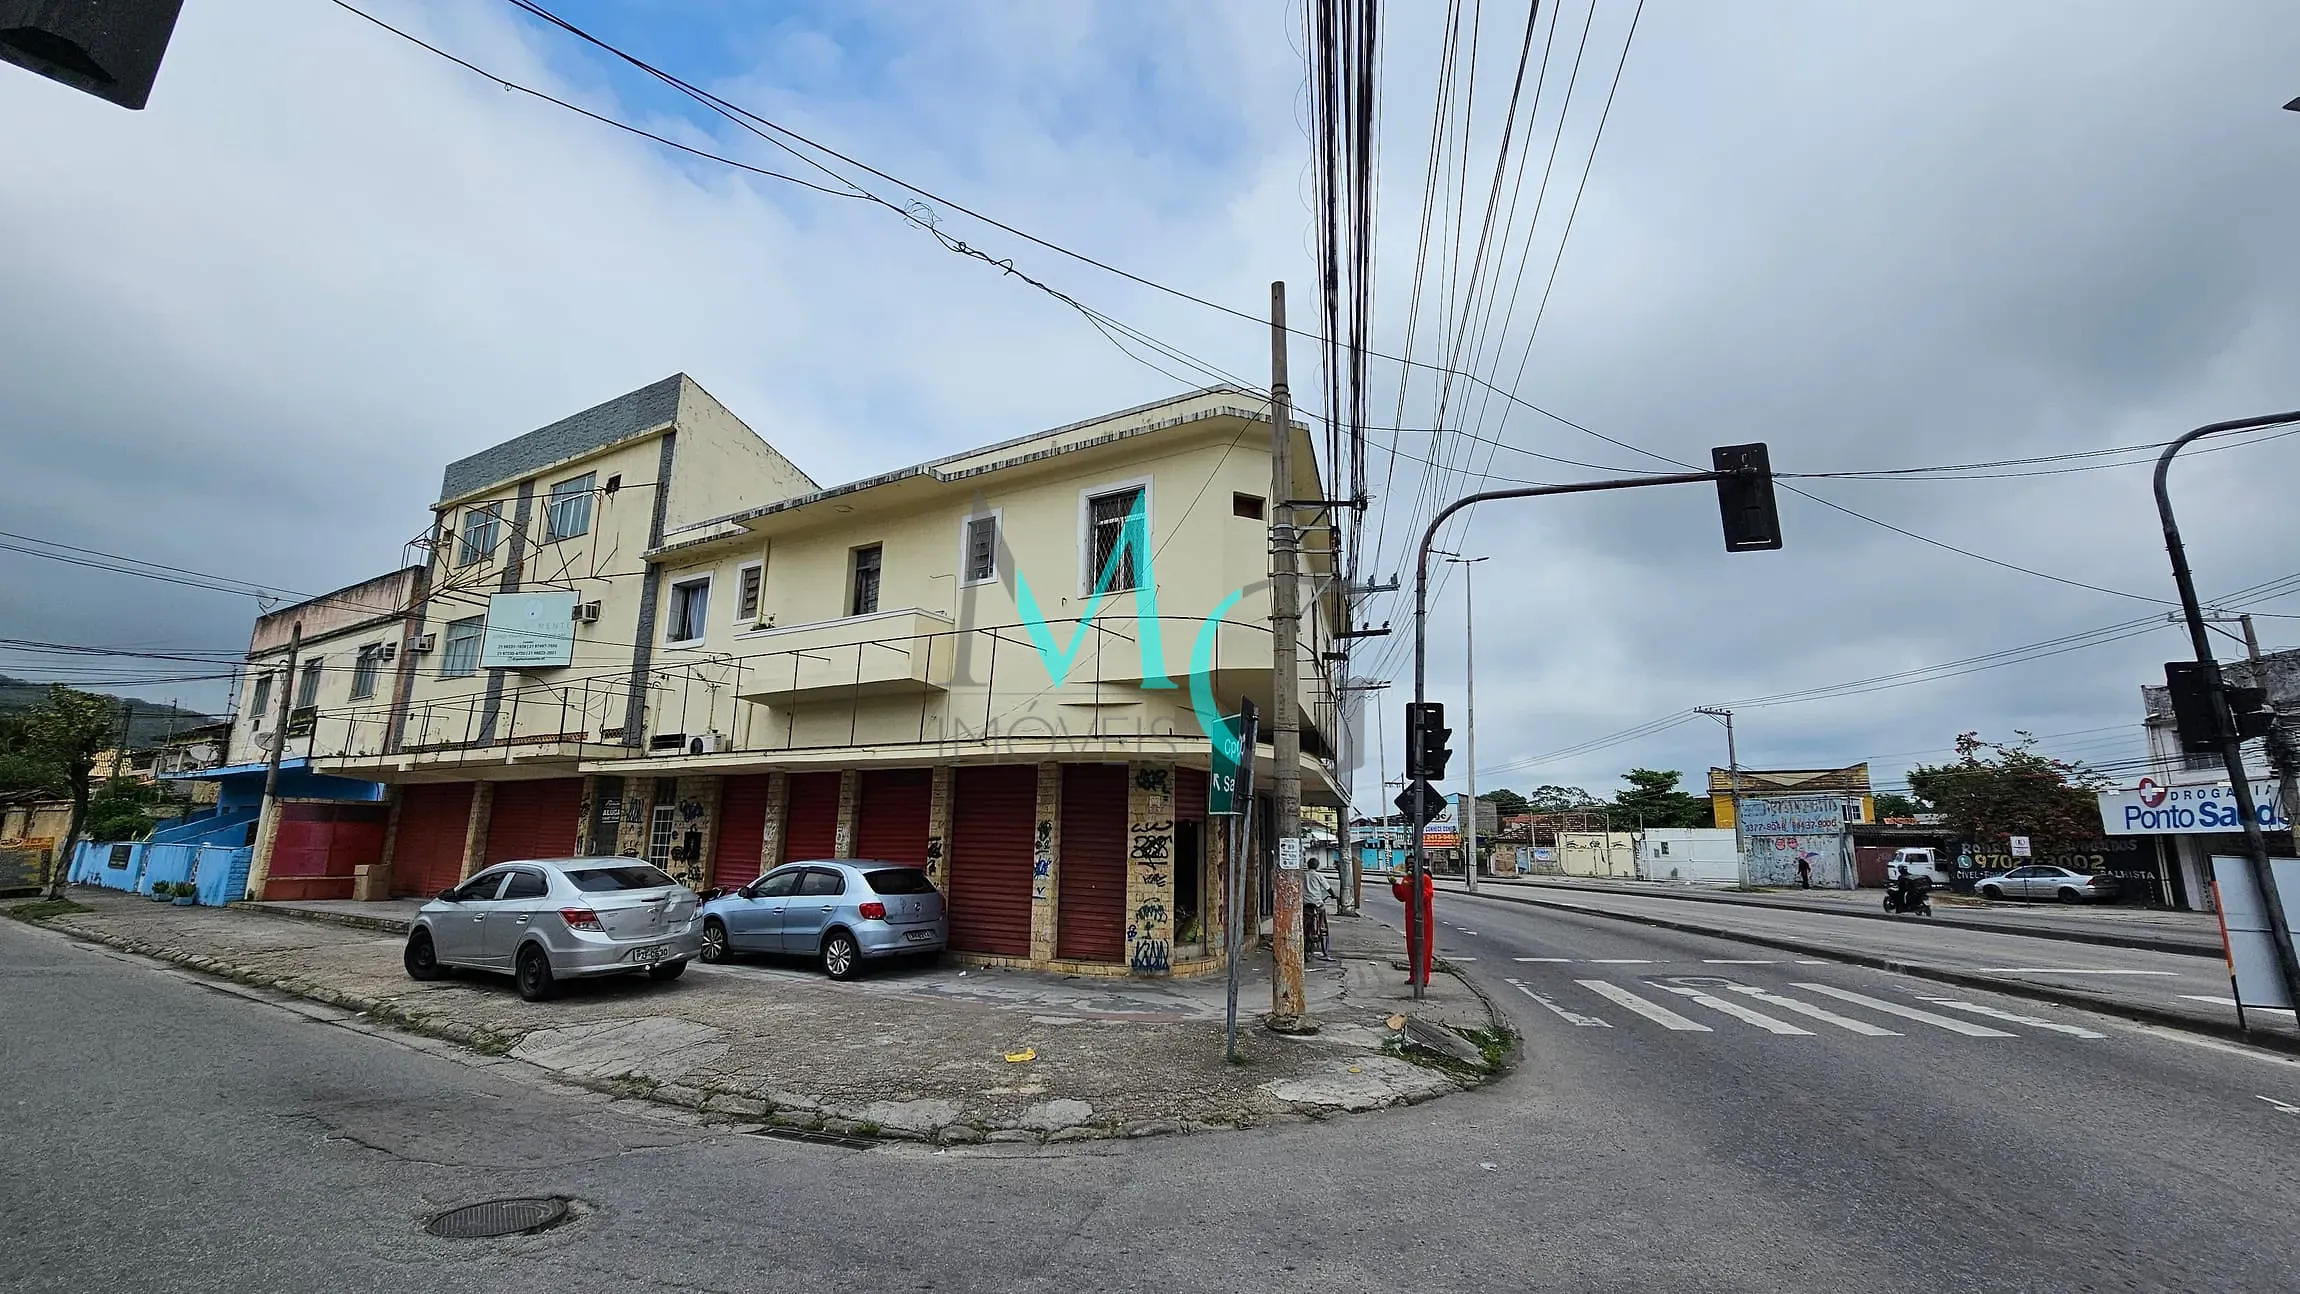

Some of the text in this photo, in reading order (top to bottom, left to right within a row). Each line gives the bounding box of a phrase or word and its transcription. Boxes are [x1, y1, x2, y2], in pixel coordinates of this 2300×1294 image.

[1223, 775, 1235, 793] Sa
[2171, 784, 2273, 801] DROGAIA
[2125, 799, 2290, 829] Ponto Sad
